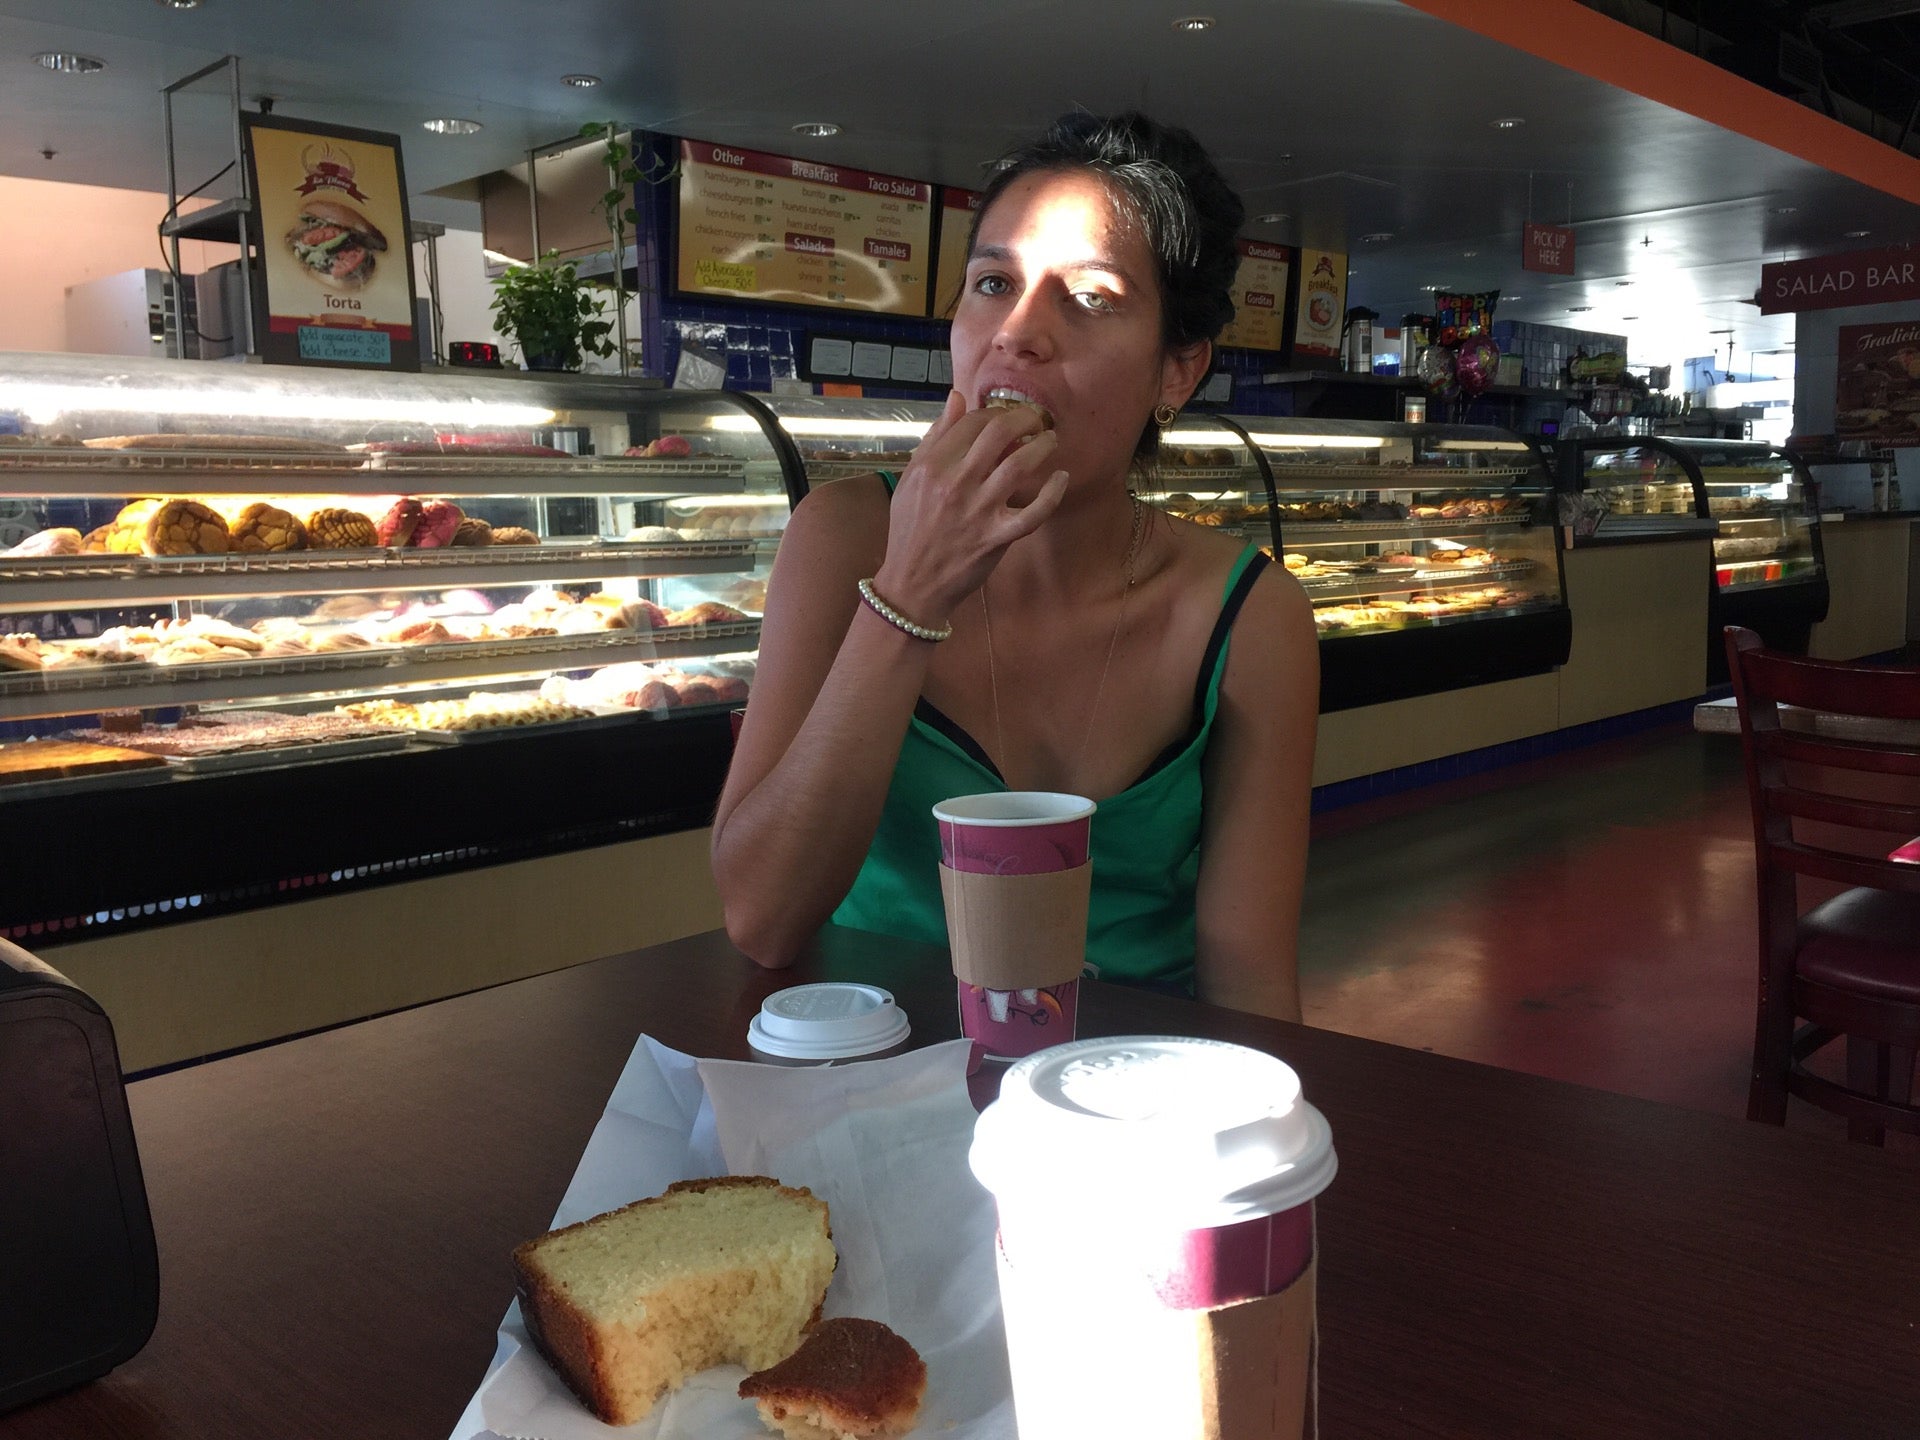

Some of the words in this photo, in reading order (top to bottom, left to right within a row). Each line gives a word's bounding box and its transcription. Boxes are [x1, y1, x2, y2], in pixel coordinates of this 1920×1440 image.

[712, 148, 745, 166] Other
[704, 169, 750, 187] hamburgers
[791, 162, 839, 183] Breakfast
[868, 177, 890, 192] Taco
[890, 181, 917, 197] Salad
[793, 238, 827, 253] Salads
[1533, 230, 1553, 247] PICK
[1555, 233, 1567, 249] UP
[868, 241, 907, 259] Tamales
[1247, 245, 1281, 260] Quesadillas
[1538, 249, 1561, 266] HERE
[1307, 280, 1339, 297] Breakfast
[1775, 270, 1855, 298] SALAD
[1866, 263, 1915, 288] BAR
[323, 294, 362, 310] Torta
[1246, 293, 1273, 307] Gorditas
[299, 327, 319, 341] Add
[301, 342, 321, 357] Add
